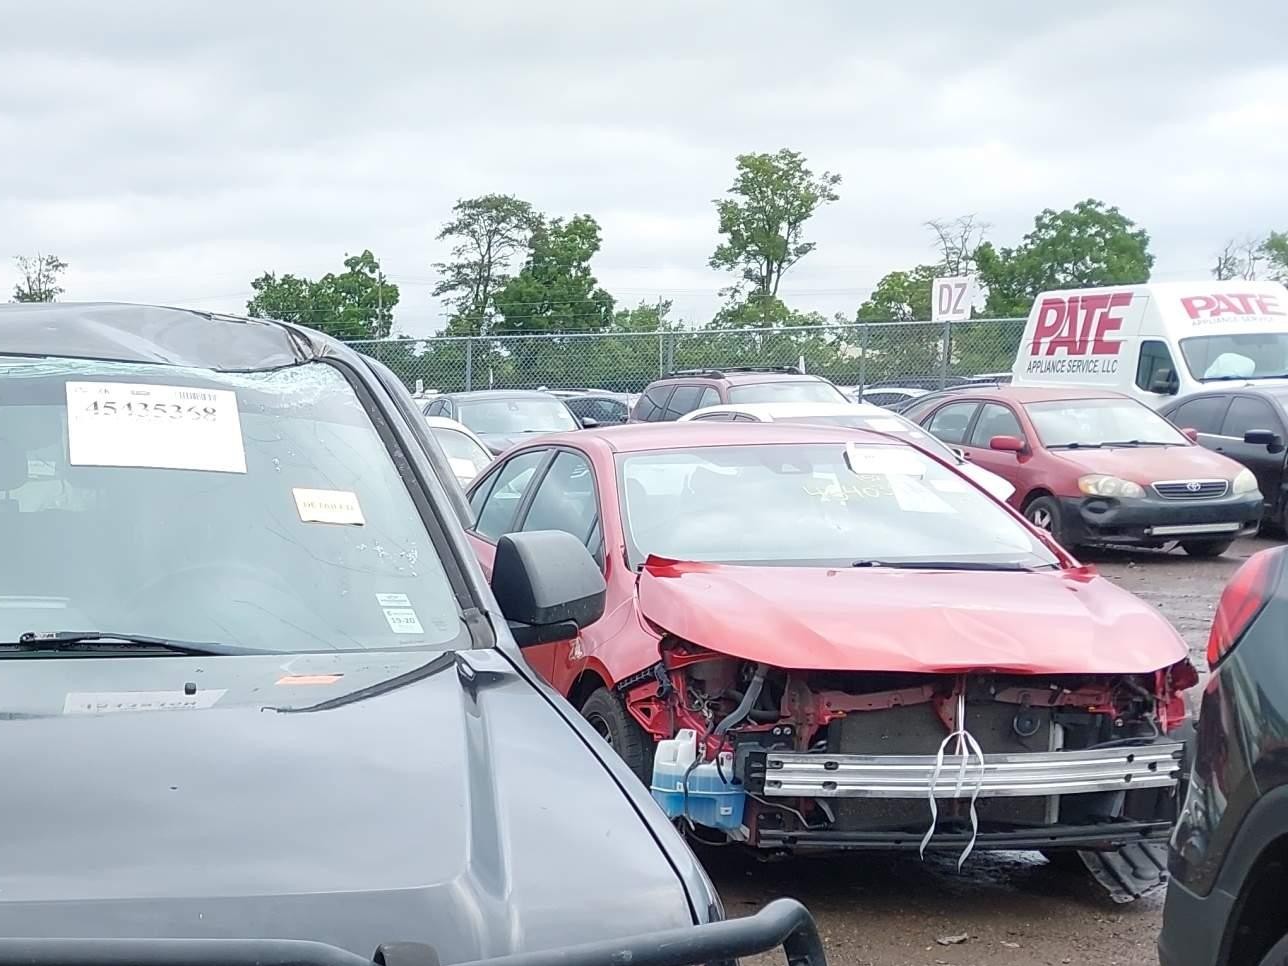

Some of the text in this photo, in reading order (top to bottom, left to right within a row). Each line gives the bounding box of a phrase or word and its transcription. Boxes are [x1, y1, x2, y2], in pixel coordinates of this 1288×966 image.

[938, 283, 968, 315] DZ
[1180, 294, 1287, 319] PATE
[1031, 293, 1133, 356] PATE
[1027, 359, 1066, 373] APPLIANCE
[1101, 359, 1118, 373] LLC
[86, 400, 217, 422] 45435368
